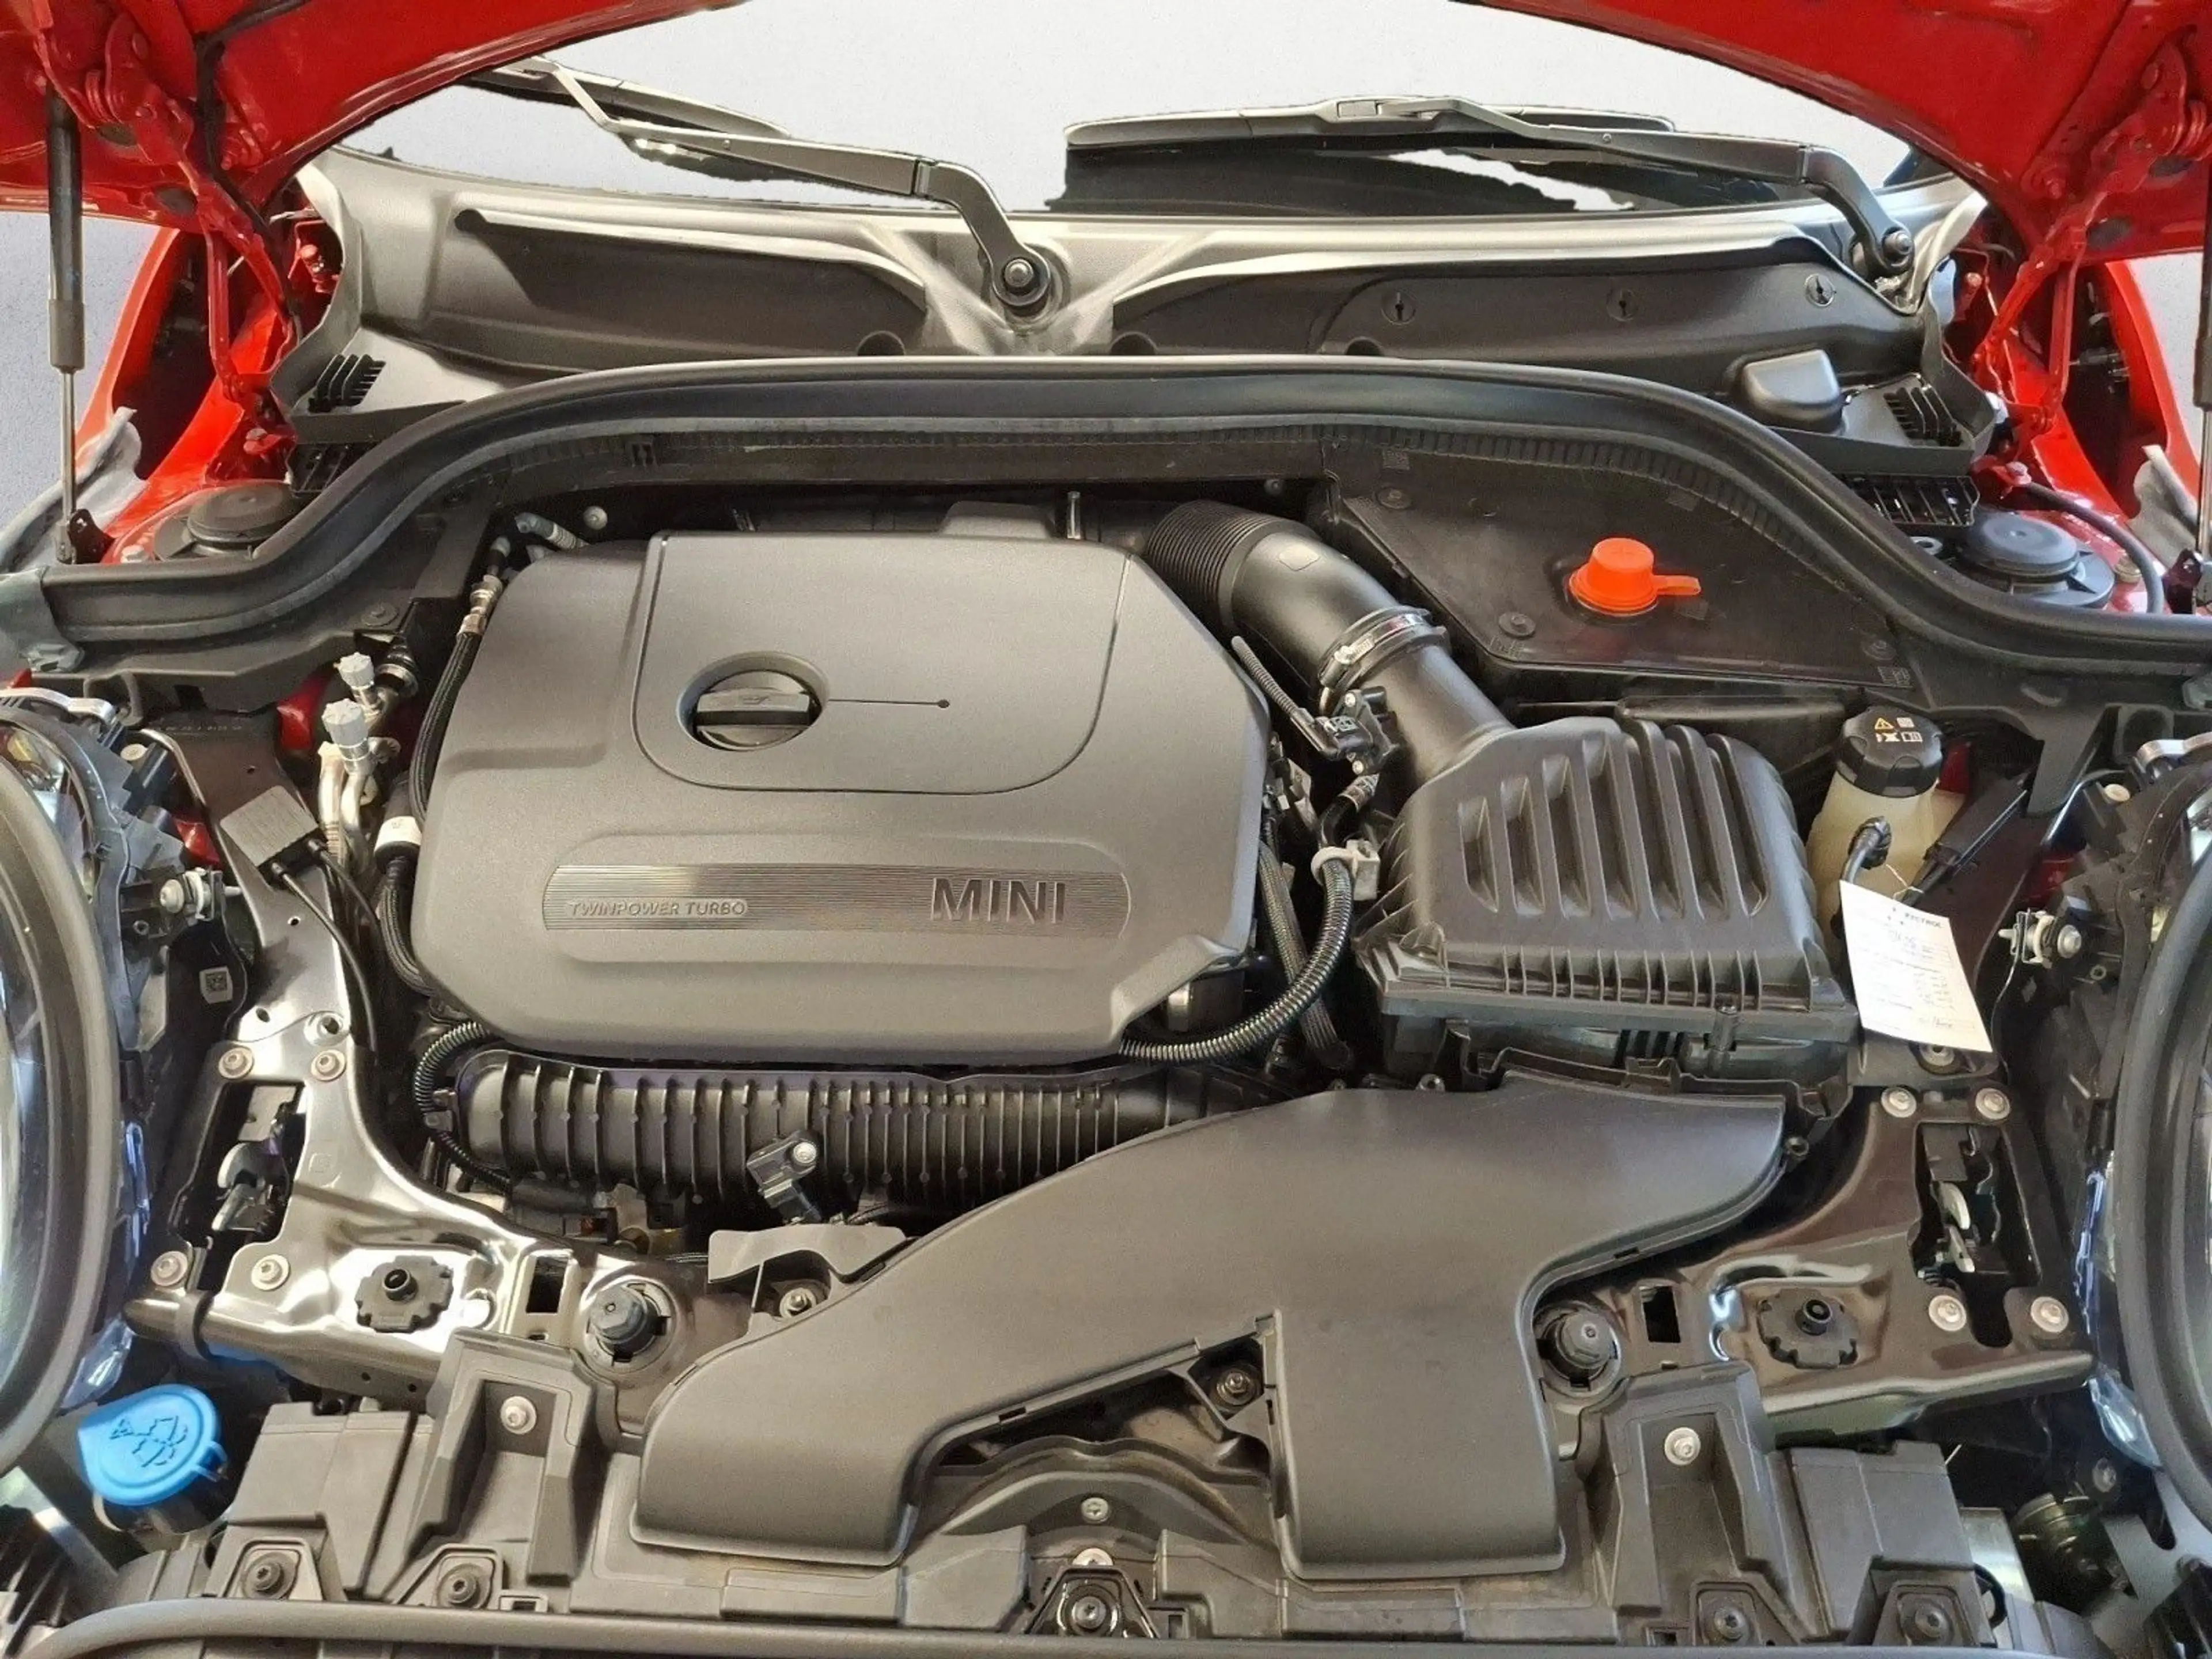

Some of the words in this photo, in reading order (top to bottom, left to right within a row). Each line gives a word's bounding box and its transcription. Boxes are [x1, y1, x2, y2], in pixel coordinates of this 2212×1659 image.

[571, 899, 679, 916] TWINPOWER
[685, 899, 745, 916] TURBO
[930, 877, 1066, 924] MINI
